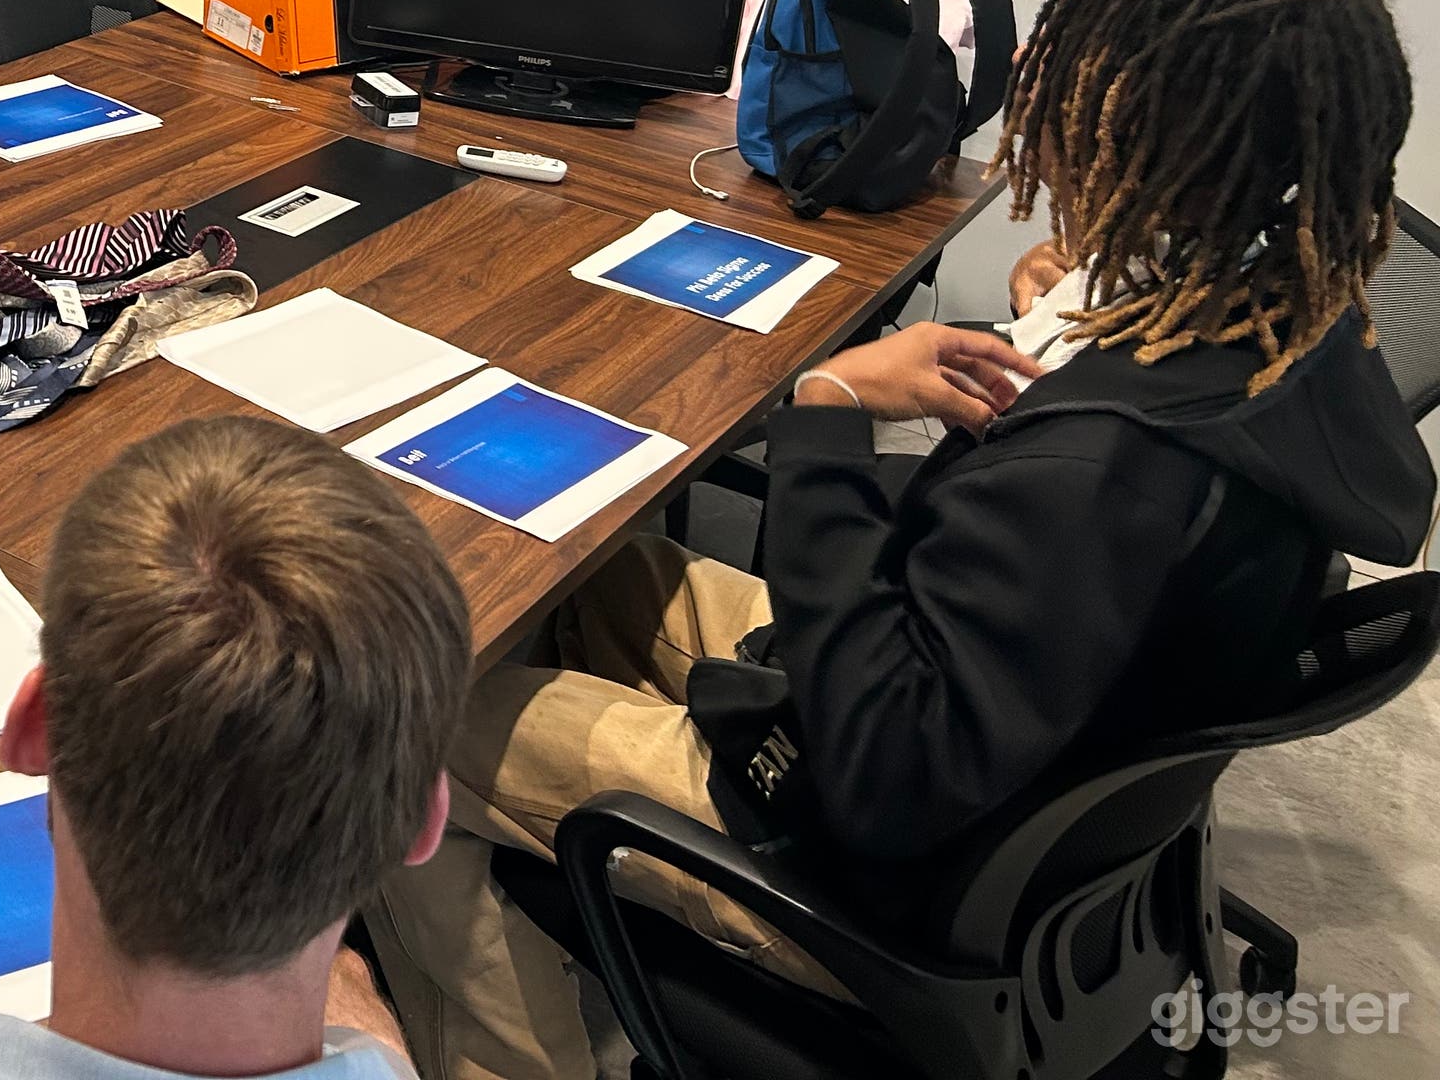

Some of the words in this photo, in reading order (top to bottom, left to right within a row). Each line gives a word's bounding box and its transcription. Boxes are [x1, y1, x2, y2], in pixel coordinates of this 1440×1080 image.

[518, 55, 551, 66] PHILIPS
[685, 281, 709, 294] Phi
[698, 271, 726, 286] Beta
[716, 257, 750, 274] Sigma
[704, 287, 734, 302] Dress
[735, 262, 772, 282] Success
[397, 449, 428, 466] Belt
